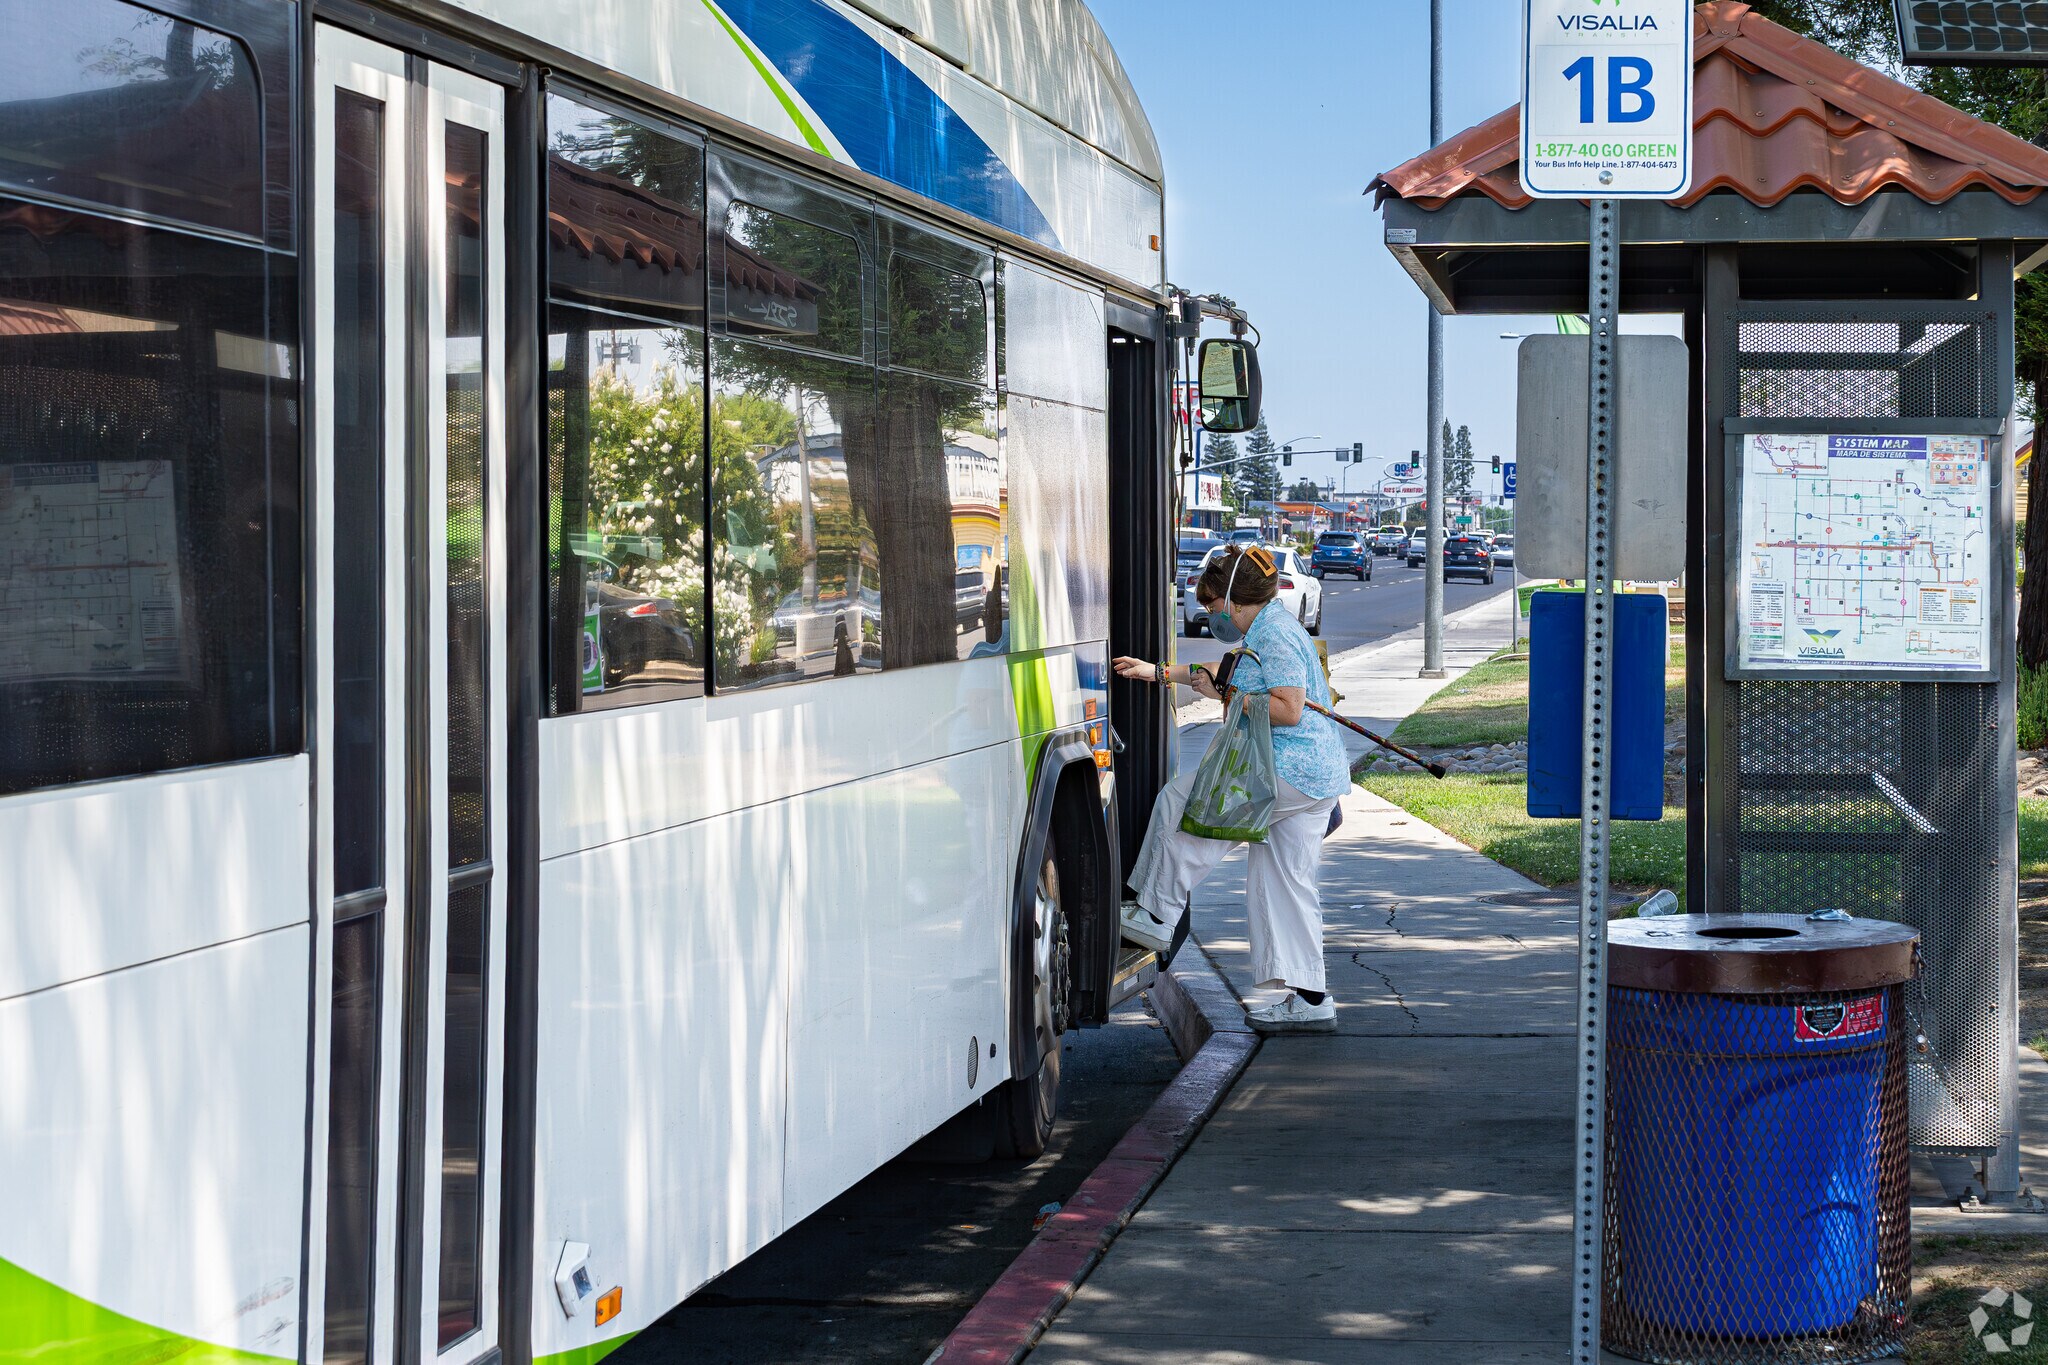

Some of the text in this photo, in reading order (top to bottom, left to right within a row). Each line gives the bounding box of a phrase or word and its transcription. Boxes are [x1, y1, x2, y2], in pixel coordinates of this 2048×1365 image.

[1557, 15, 1658, 30] VISALIA
[1562, 56, 1656, 124] 1B
[1535, 143, 1677, 158] 1-877-40 GO GREEN
[1534, 160, 1551, 168] Your
[1552, 160, 1566, 168] Bus
[1567, 160, 1582, 168] Info
[1583, 160, 1601, 169] Help
[1620, 160, 1678, 169] 1-877-404-6473
[1835, 438, 1909, 449] SYSTEM MAP
[1859, 450, 1871, 458] DE
[1872, 451, 1907, 459] SISTEMA
[1798, 647, 1844, 655] VISALIA
